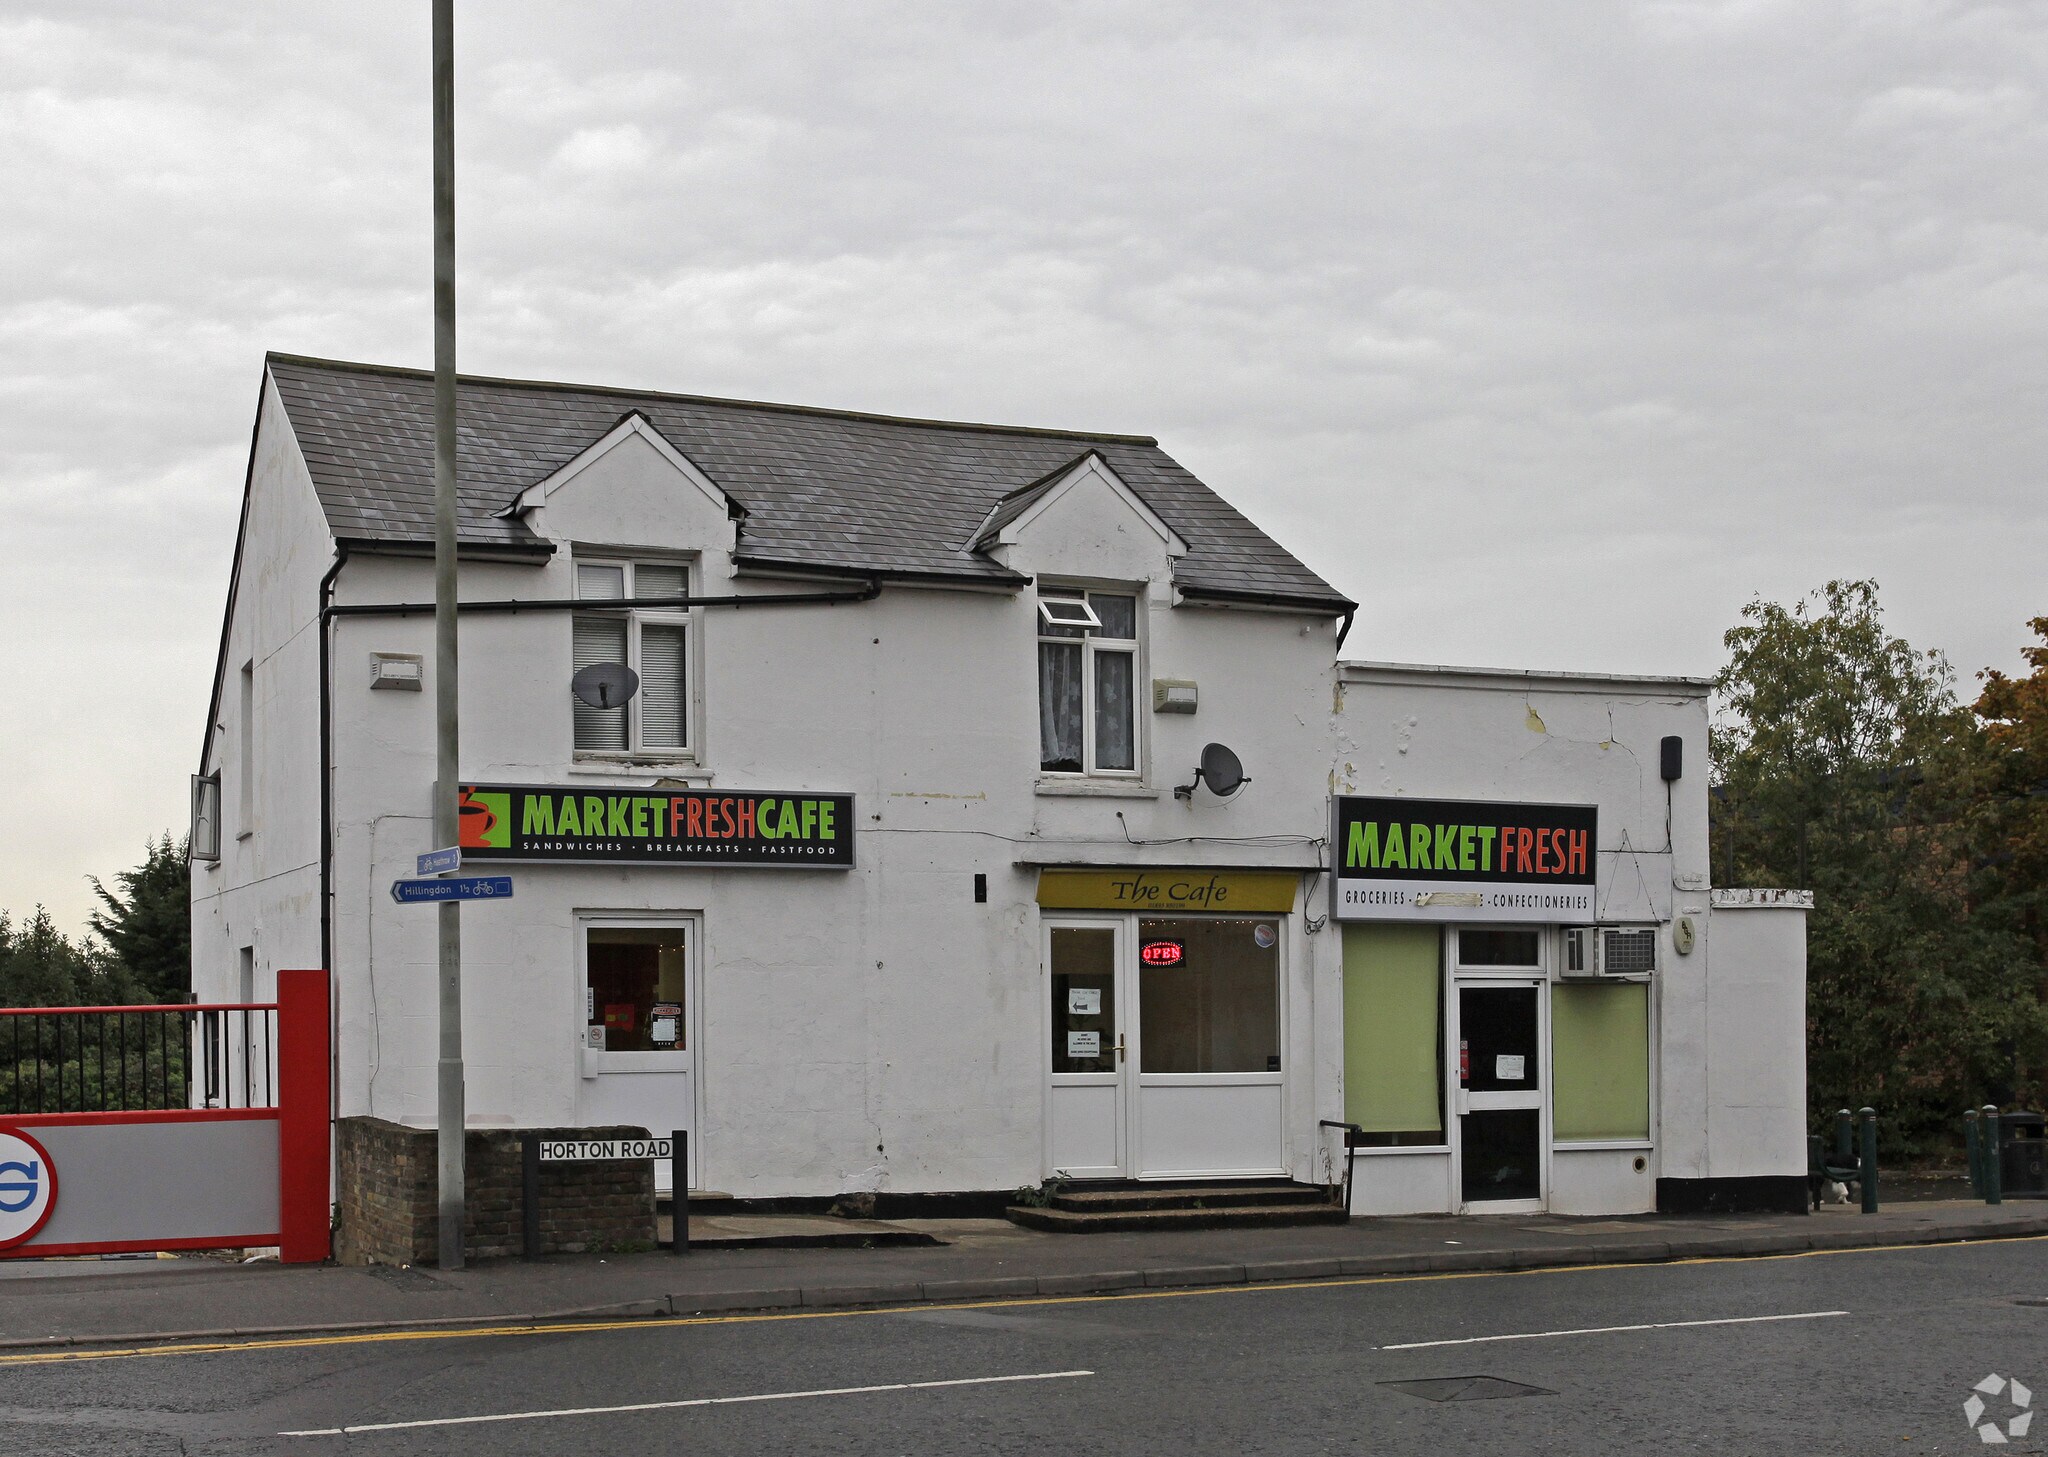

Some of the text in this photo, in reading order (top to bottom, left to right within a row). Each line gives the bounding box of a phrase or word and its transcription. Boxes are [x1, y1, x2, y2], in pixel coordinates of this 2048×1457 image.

[523, 841, 836, 855] SANDWICHES BREAKFASTS FASTFOOD
[1346, 821, 1587, 875] MARKET FRESH
[405, 885, 452, 896] Hillingdon
[1111, 874, 1227, 907] The Cafe
[1345, 890, 1405, 904] GROCERIES
[1493, 894, 1588, 909] CONFECTIONERIES
[1143, 947, 1180, 959] OPEN
[541, 1140, 671, 1159] HORTON ROAD
